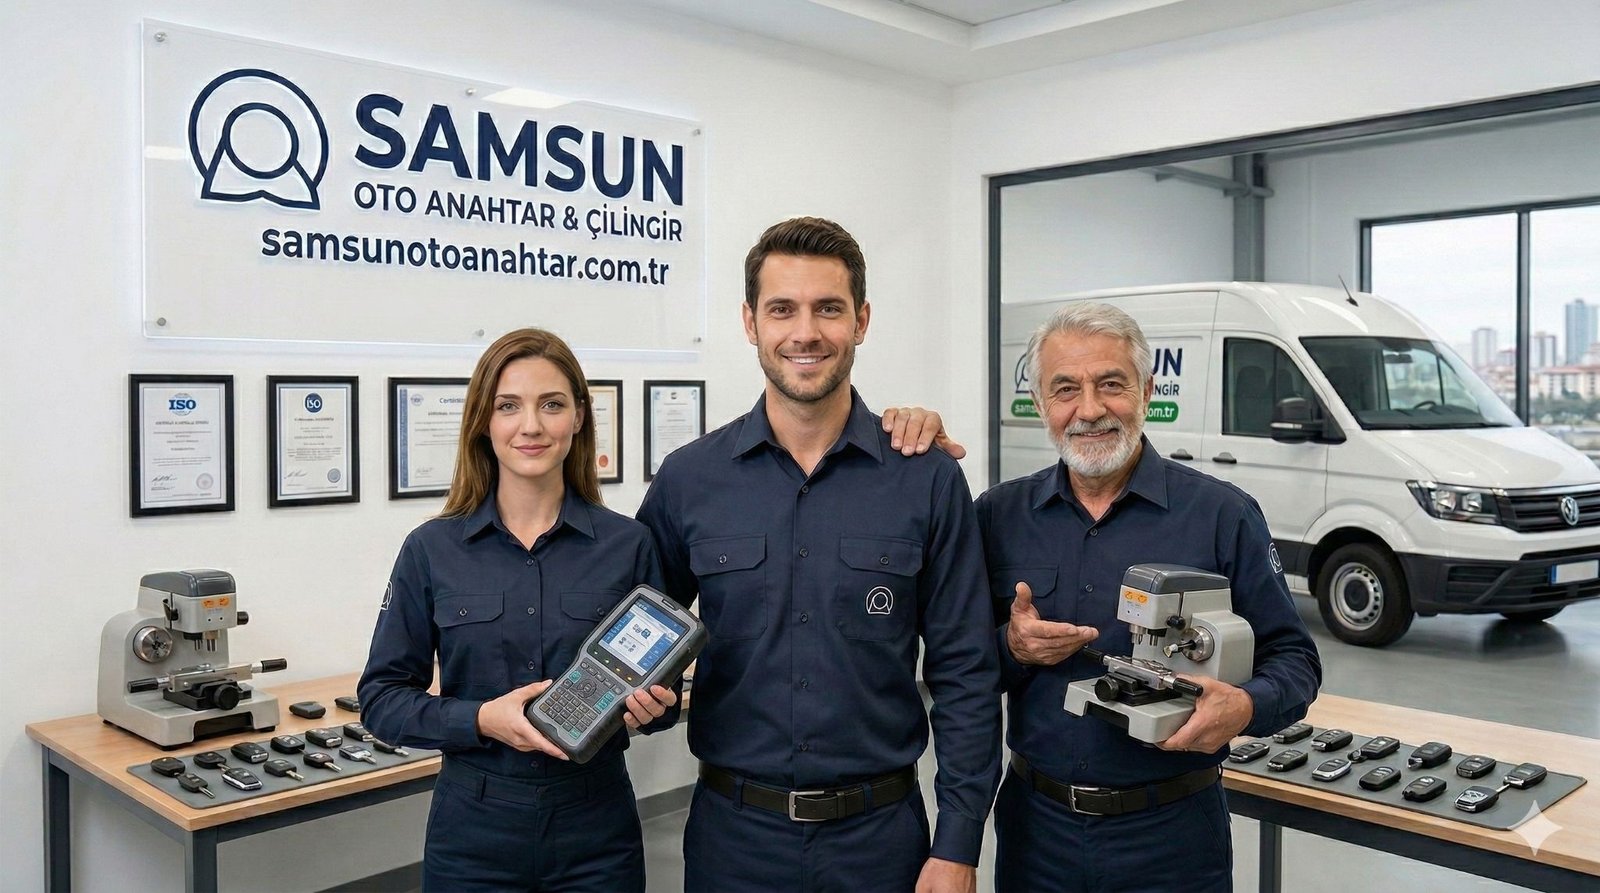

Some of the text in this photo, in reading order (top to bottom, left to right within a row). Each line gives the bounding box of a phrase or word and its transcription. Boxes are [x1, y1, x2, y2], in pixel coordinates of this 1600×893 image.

[354, 93, 684, 207] SAMSUN
[354, 181, 682, 242] OTO ANAHTAR & ÇİLİNGİR
[261, 228, 670, 286] samsunotoanahtar.com.tr
[168, 399, 197, 411] ISO
